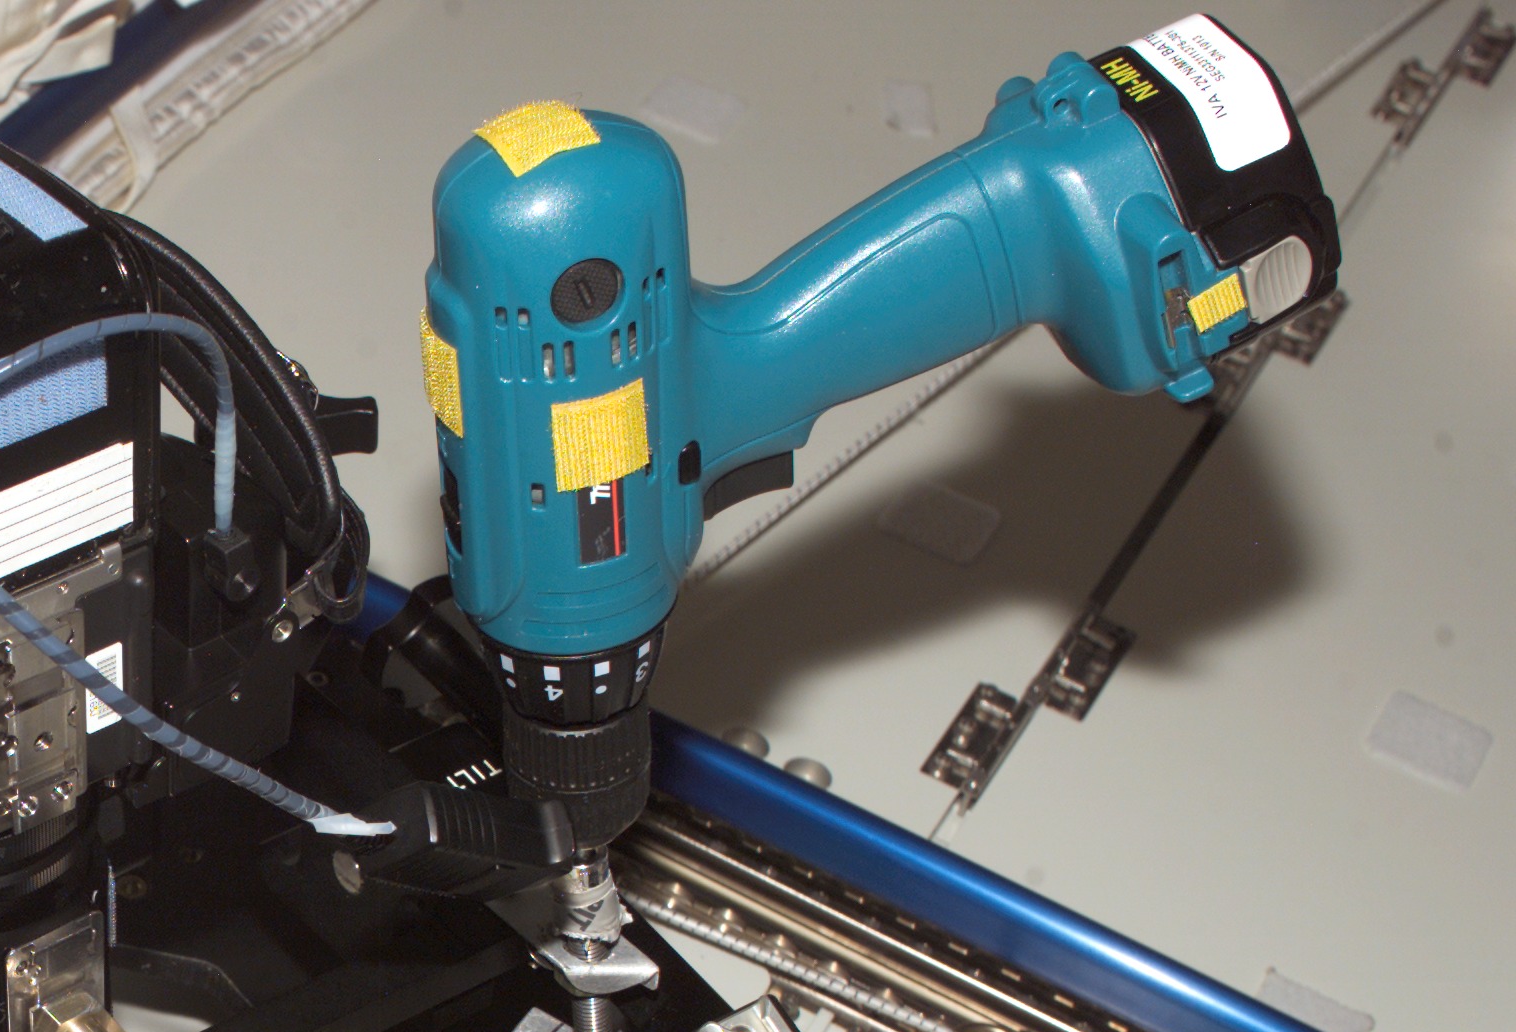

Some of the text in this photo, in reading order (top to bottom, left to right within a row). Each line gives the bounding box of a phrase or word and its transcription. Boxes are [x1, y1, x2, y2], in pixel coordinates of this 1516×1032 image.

[1167, 54, 1196, 77] NiMH
[1099, 57, 1159, 103] Ni-MH
[1189, 74, 1211, 91] 12V
[1207, 92, 1227, 119] IVA
[635, 660, 648, 683] 3
[543, 684, 563, 701] 4
